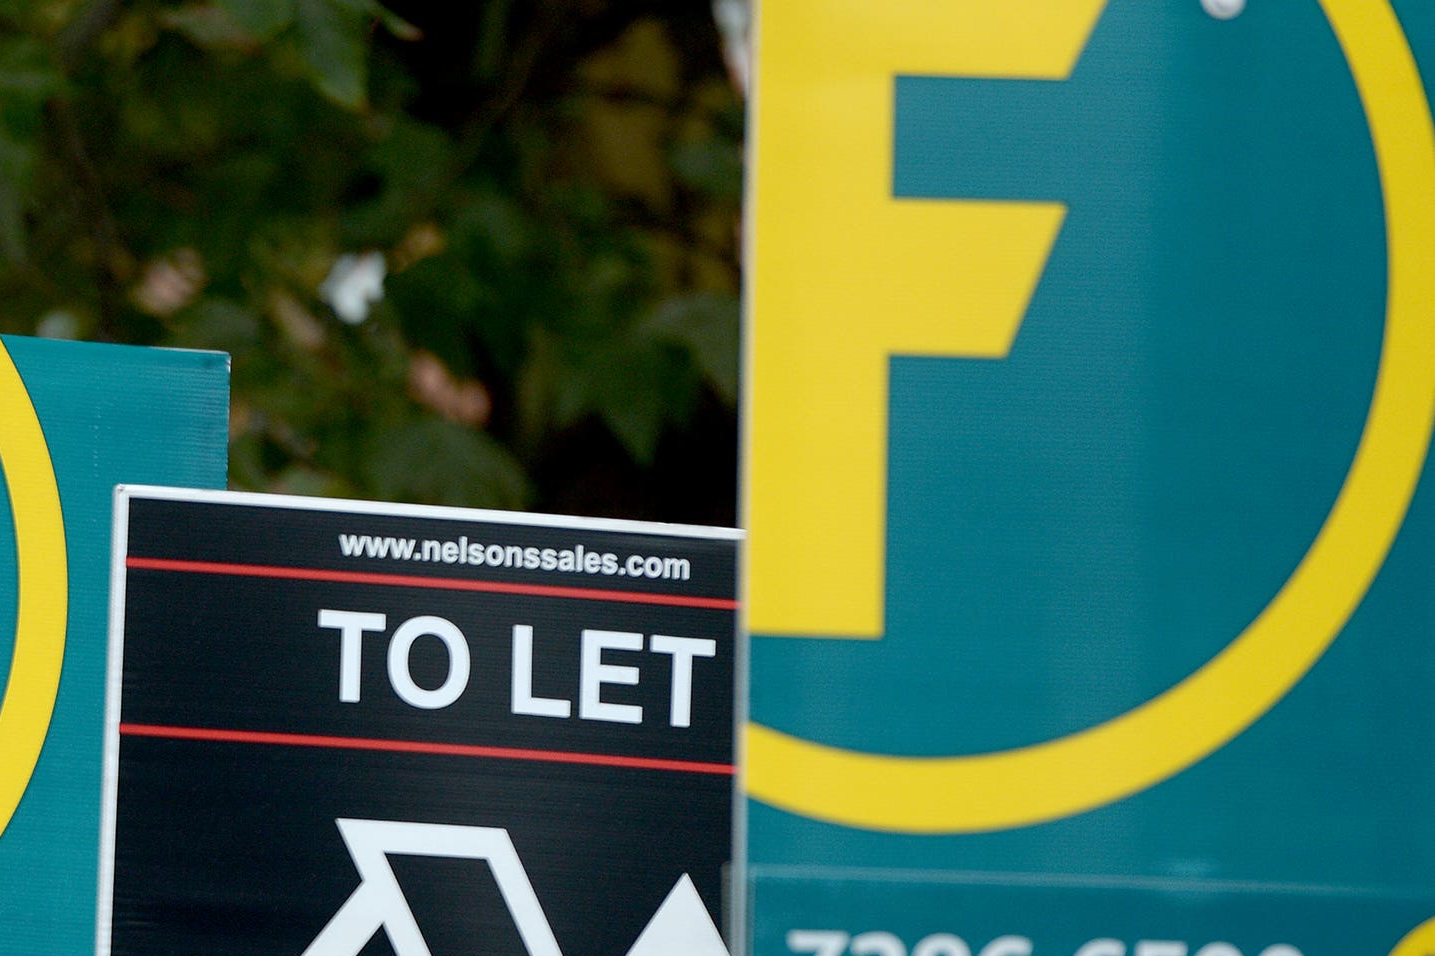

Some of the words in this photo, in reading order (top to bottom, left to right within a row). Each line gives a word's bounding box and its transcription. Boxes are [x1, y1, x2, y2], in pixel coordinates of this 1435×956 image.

[338, 533, 691, 580] www.nelsonssales.com
[317, 608, 471, 711] TO
[510, 624, 717, 728] LET
